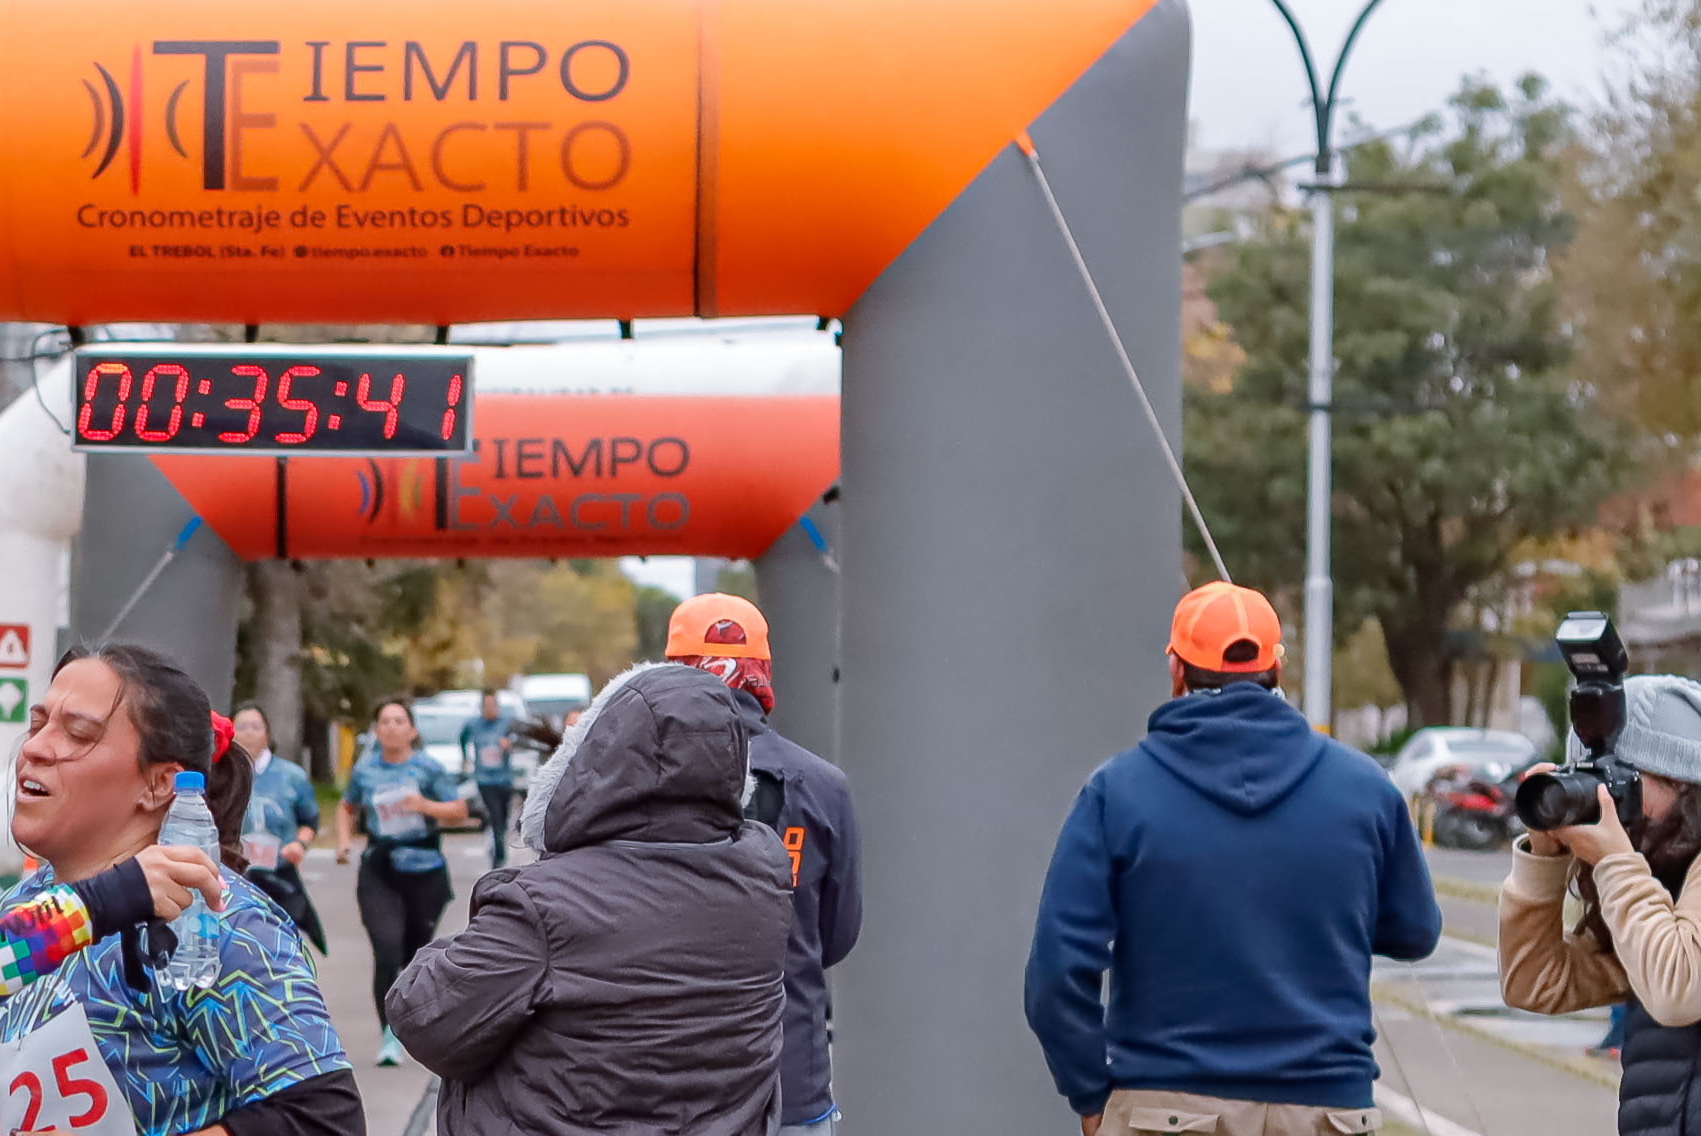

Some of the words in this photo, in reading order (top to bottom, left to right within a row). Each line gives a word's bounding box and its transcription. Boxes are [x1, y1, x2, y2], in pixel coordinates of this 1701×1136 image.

[153, 40, 630, 190] TIEMPO
[230, 60, 632, 192] EXACTO
[76, 204, 281, 234] Cronometraje
[289, 205, 326, 228] de
[336, 204, 453, 228] Eventos
[462, 204, 630, 232] Deportivos
[129, 244, 147, 257] EL
[77, 362, 463, 444] 00:35:41
